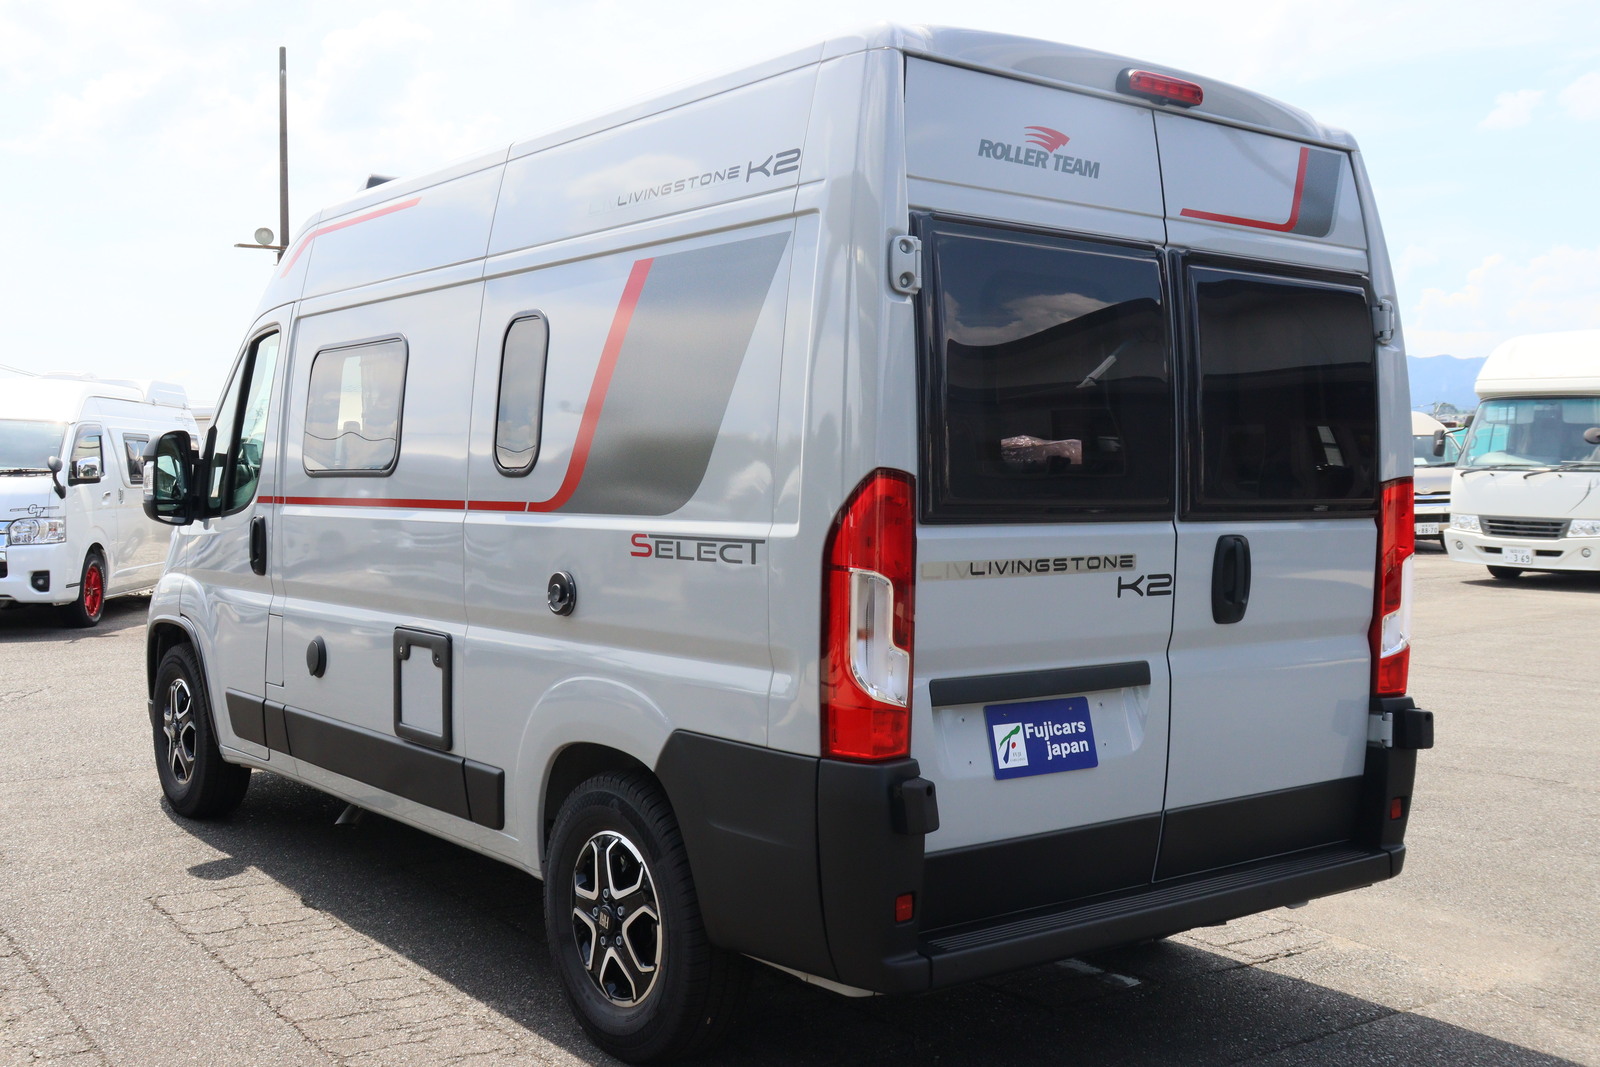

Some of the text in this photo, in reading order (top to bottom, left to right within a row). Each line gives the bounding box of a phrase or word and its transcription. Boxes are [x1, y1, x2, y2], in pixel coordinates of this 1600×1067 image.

[978, 138, 1101, 179] ROLLER TEAM
[617, 147, 801, 206] LIVINGSTONE K2
[630, 533, 766, 565] SELECT
[969, 554, 1134, 577] LIVINGSTONE
[1117, 573, 1173, 599] K2
[1024, 721, 1086, 741] Fujicars
[1047, 740, 1089, 760] japan
